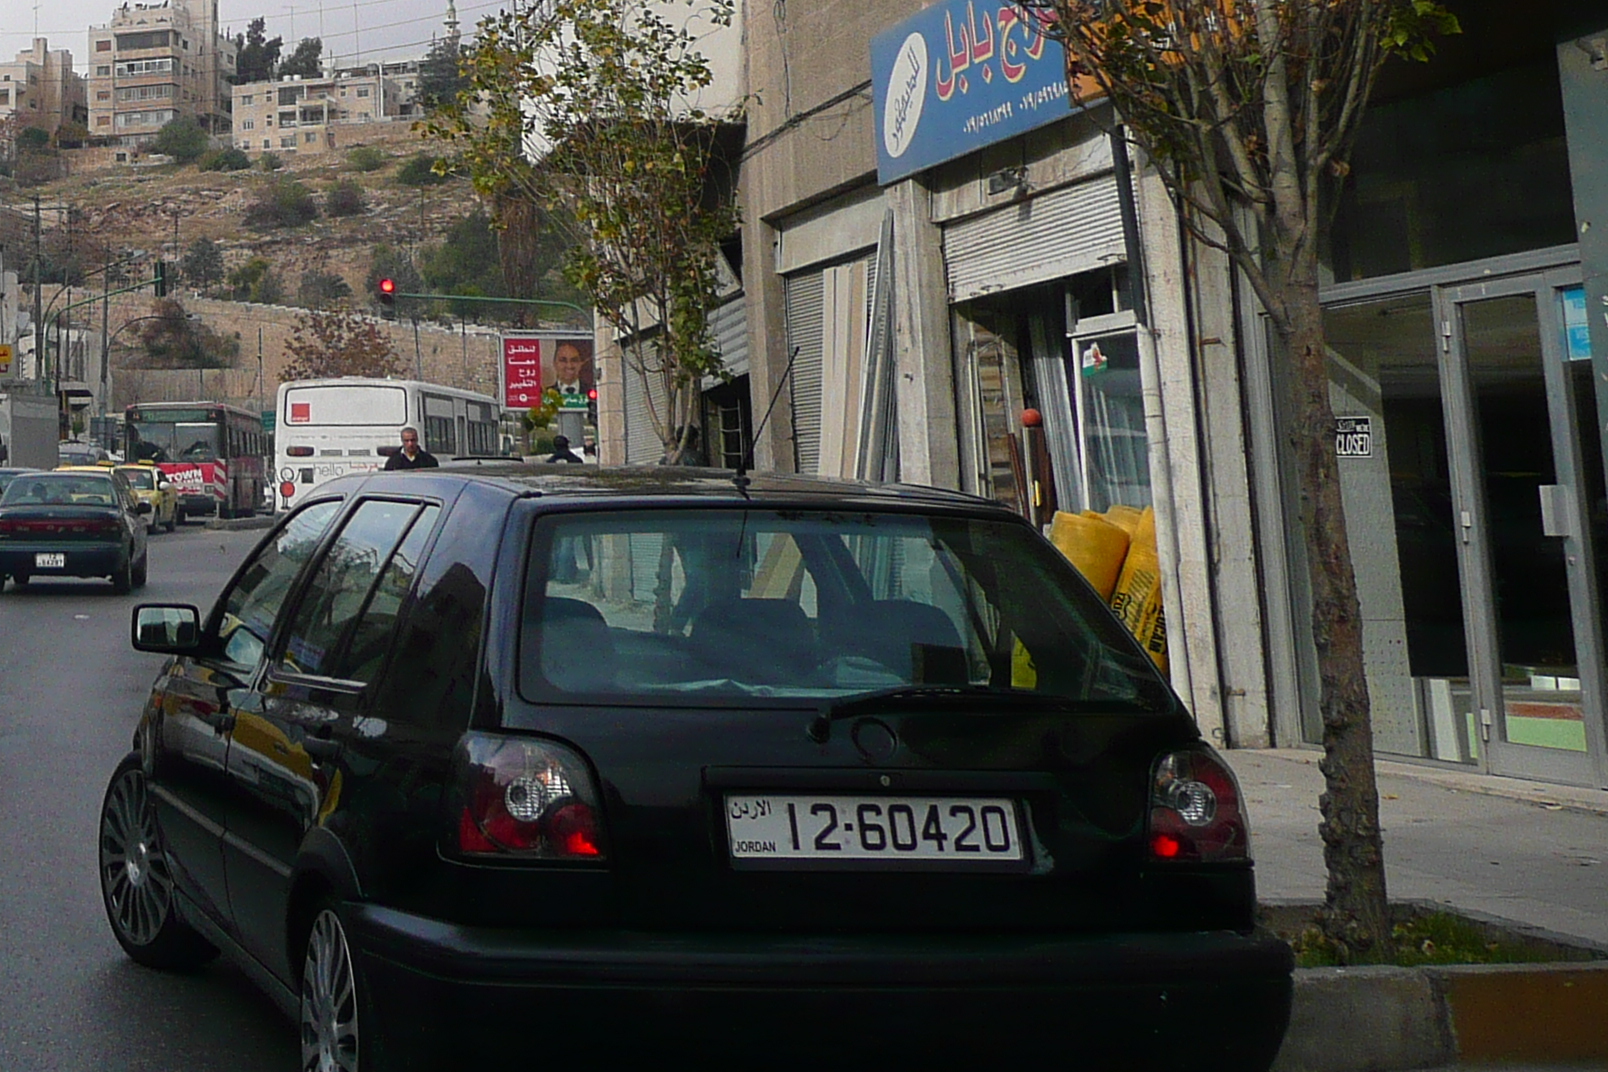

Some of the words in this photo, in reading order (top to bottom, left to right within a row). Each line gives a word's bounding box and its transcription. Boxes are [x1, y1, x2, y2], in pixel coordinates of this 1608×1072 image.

[1336, 433, 1370, 455] CLOSED
[165, 468, 203, 483] TOWN
[313, 462, 344, 477] hello
[734, 840, 776, 853] JORDAN
